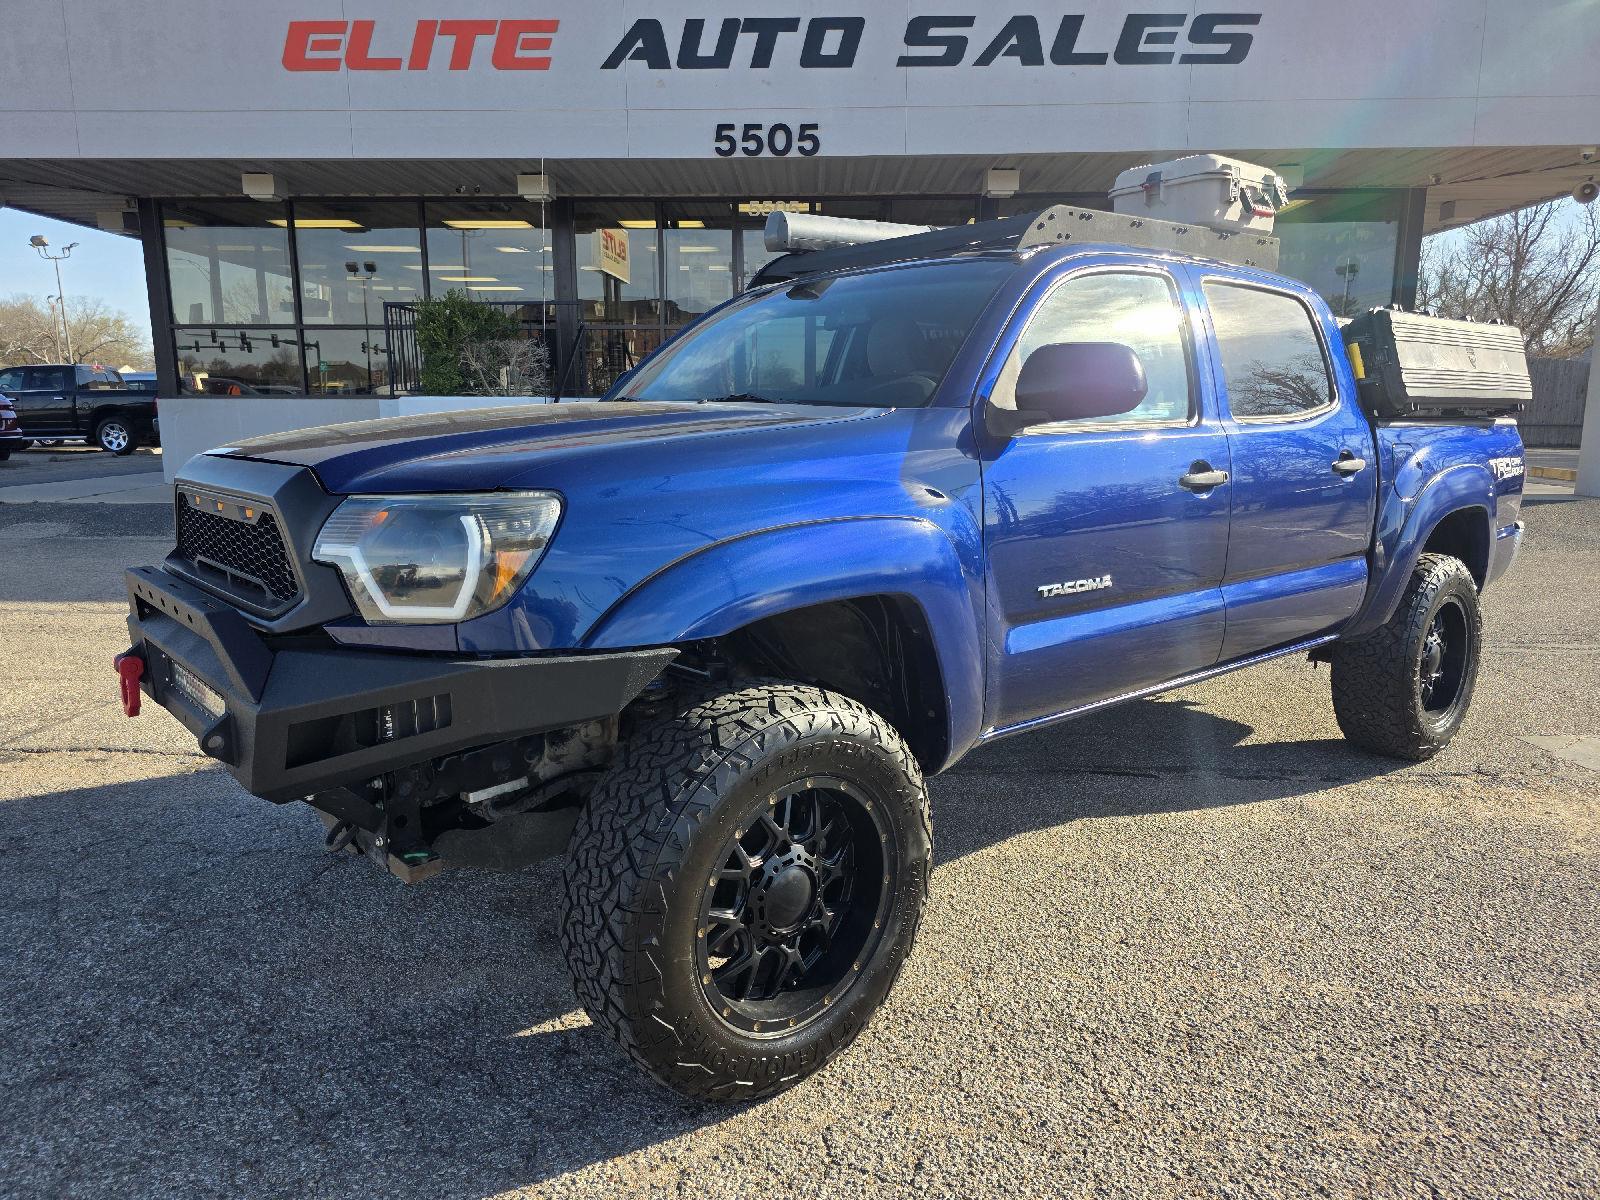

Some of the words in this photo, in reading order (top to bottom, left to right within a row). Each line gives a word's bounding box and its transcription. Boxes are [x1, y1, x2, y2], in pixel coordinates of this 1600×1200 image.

[282, 19, 560, 72] ELITE
[600, 16, 866, 70] AUTO
[896, 13, 1262, 68] SALES
[714, 122, 820, 157] 5505
[1038, 575, 1112, 598] TACOMA
